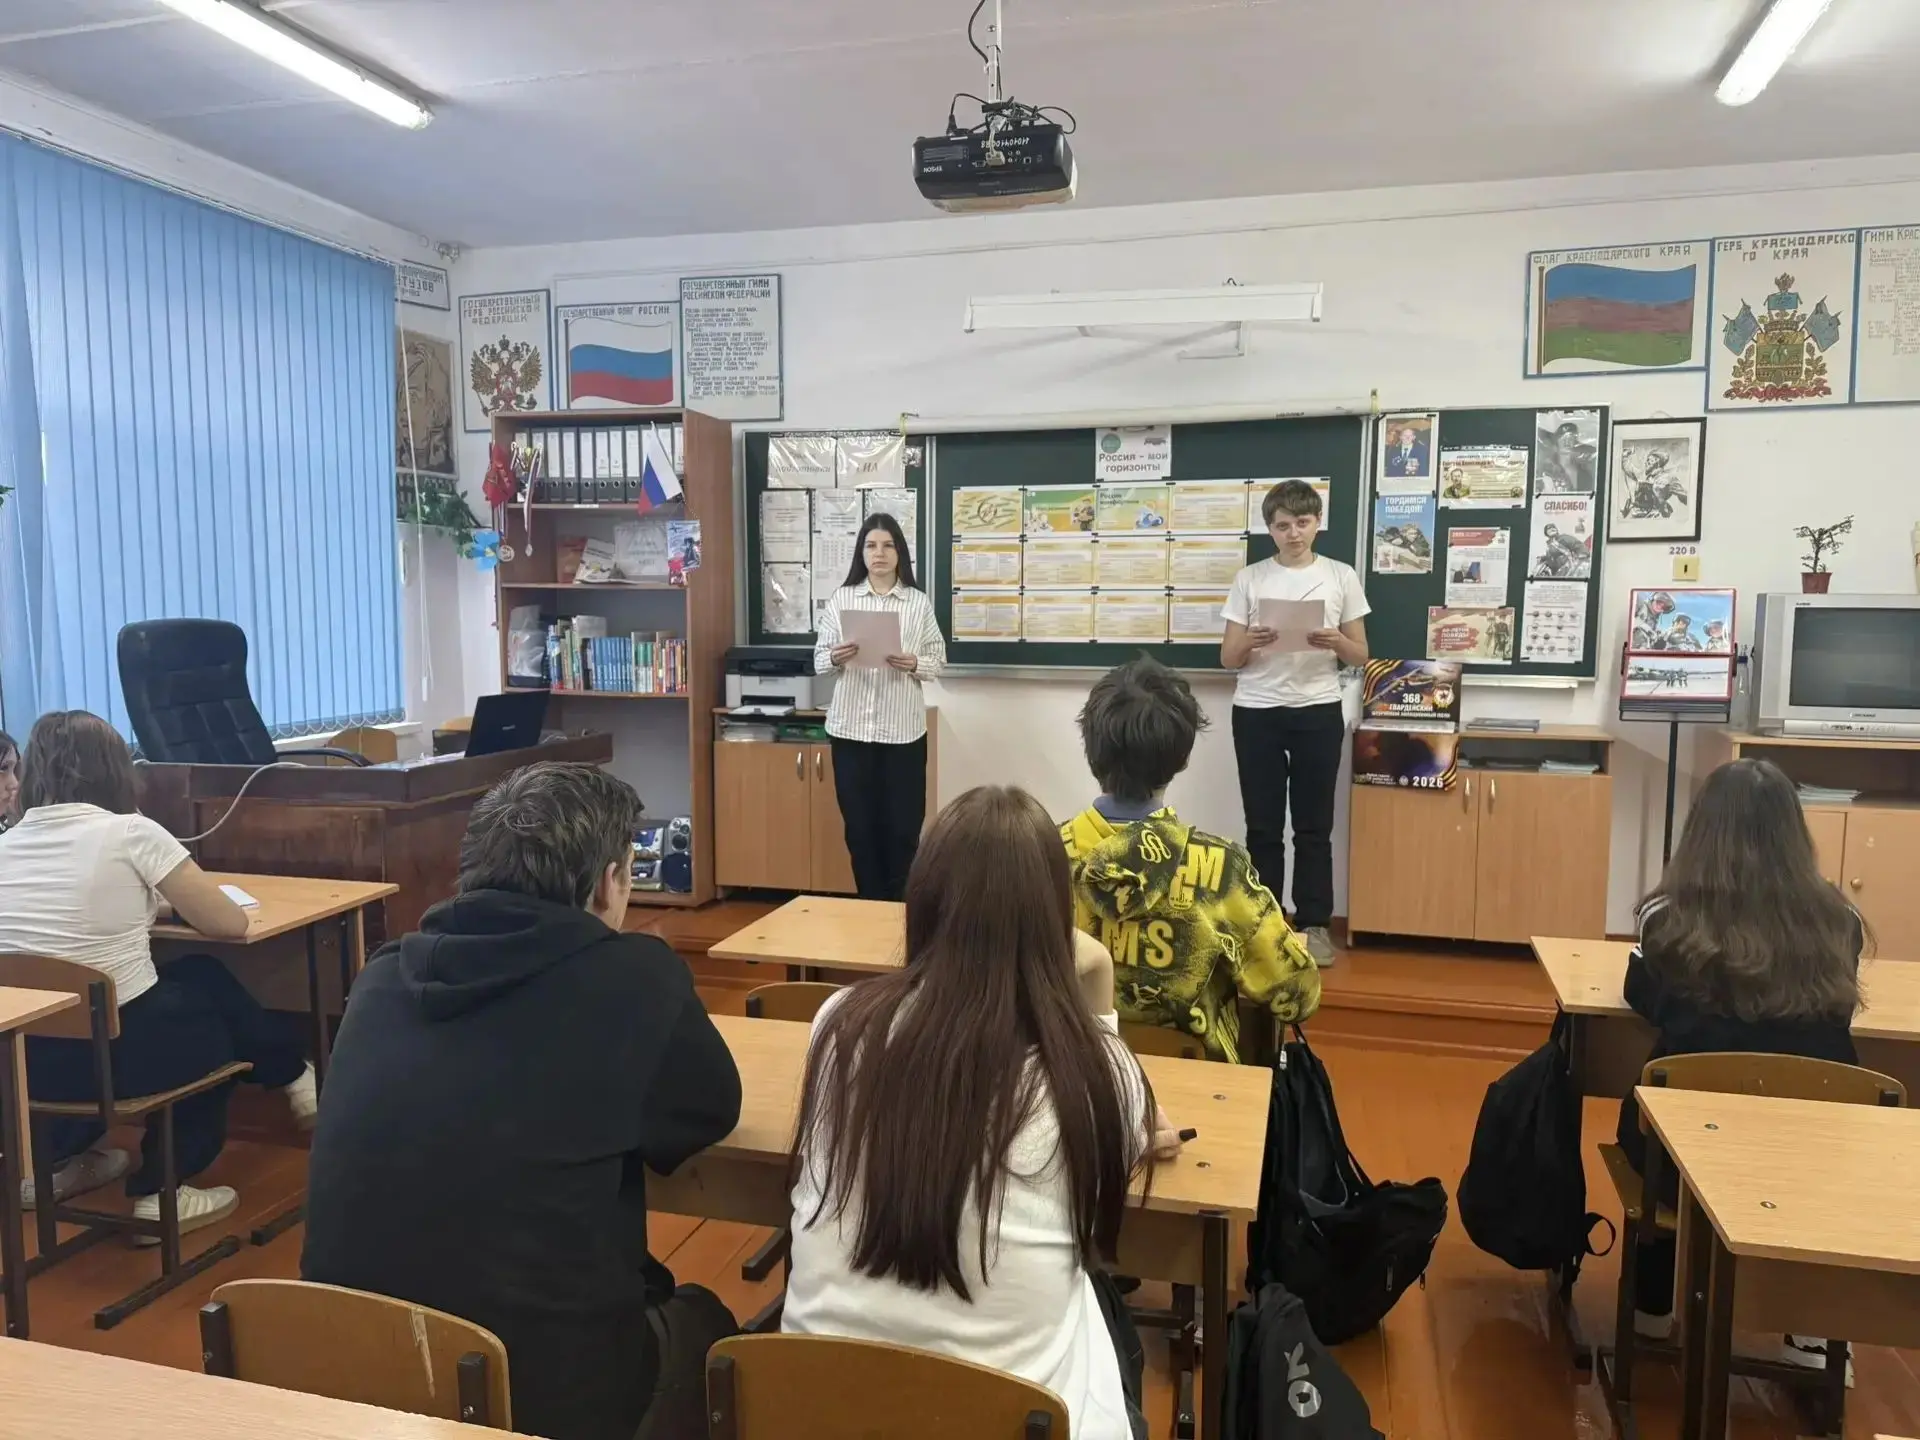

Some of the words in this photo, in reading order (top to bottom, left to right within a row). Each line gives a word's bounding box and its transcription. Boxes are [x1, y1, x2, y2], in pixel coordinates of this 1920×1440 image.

[1864, 230, 1893, 243] ГИМН
[1716, 241, 1743, 252] ГЕРБ
[1751, 233, 1855, 249] КРАСНОДАРСКО
[1533, 253, 1560, 264] ФЛАГ
[1566, 248, 1651, 263] КРАСНОДАРСКОГО
[1659, 245, 1691, 256] КРАЯ
[1742, 251, 1757, 262] ГО
[1773, 248, 1809, 260] КРАЯ
[638, 304, 670, 315] РОССИИ
[1098, 453, 1136, 462] Россия
[1105, 464, 1161, 474] горизонты
[1385, 496, 1427, 505] ГОРДИМСЯ
[1544, 501, 1588, 511] СПАСИБО!
[1669, 546, 1687, 555] 220
[1402, 693, 1420, 703] 368
[1412, 775, 1444, 788] 2026
